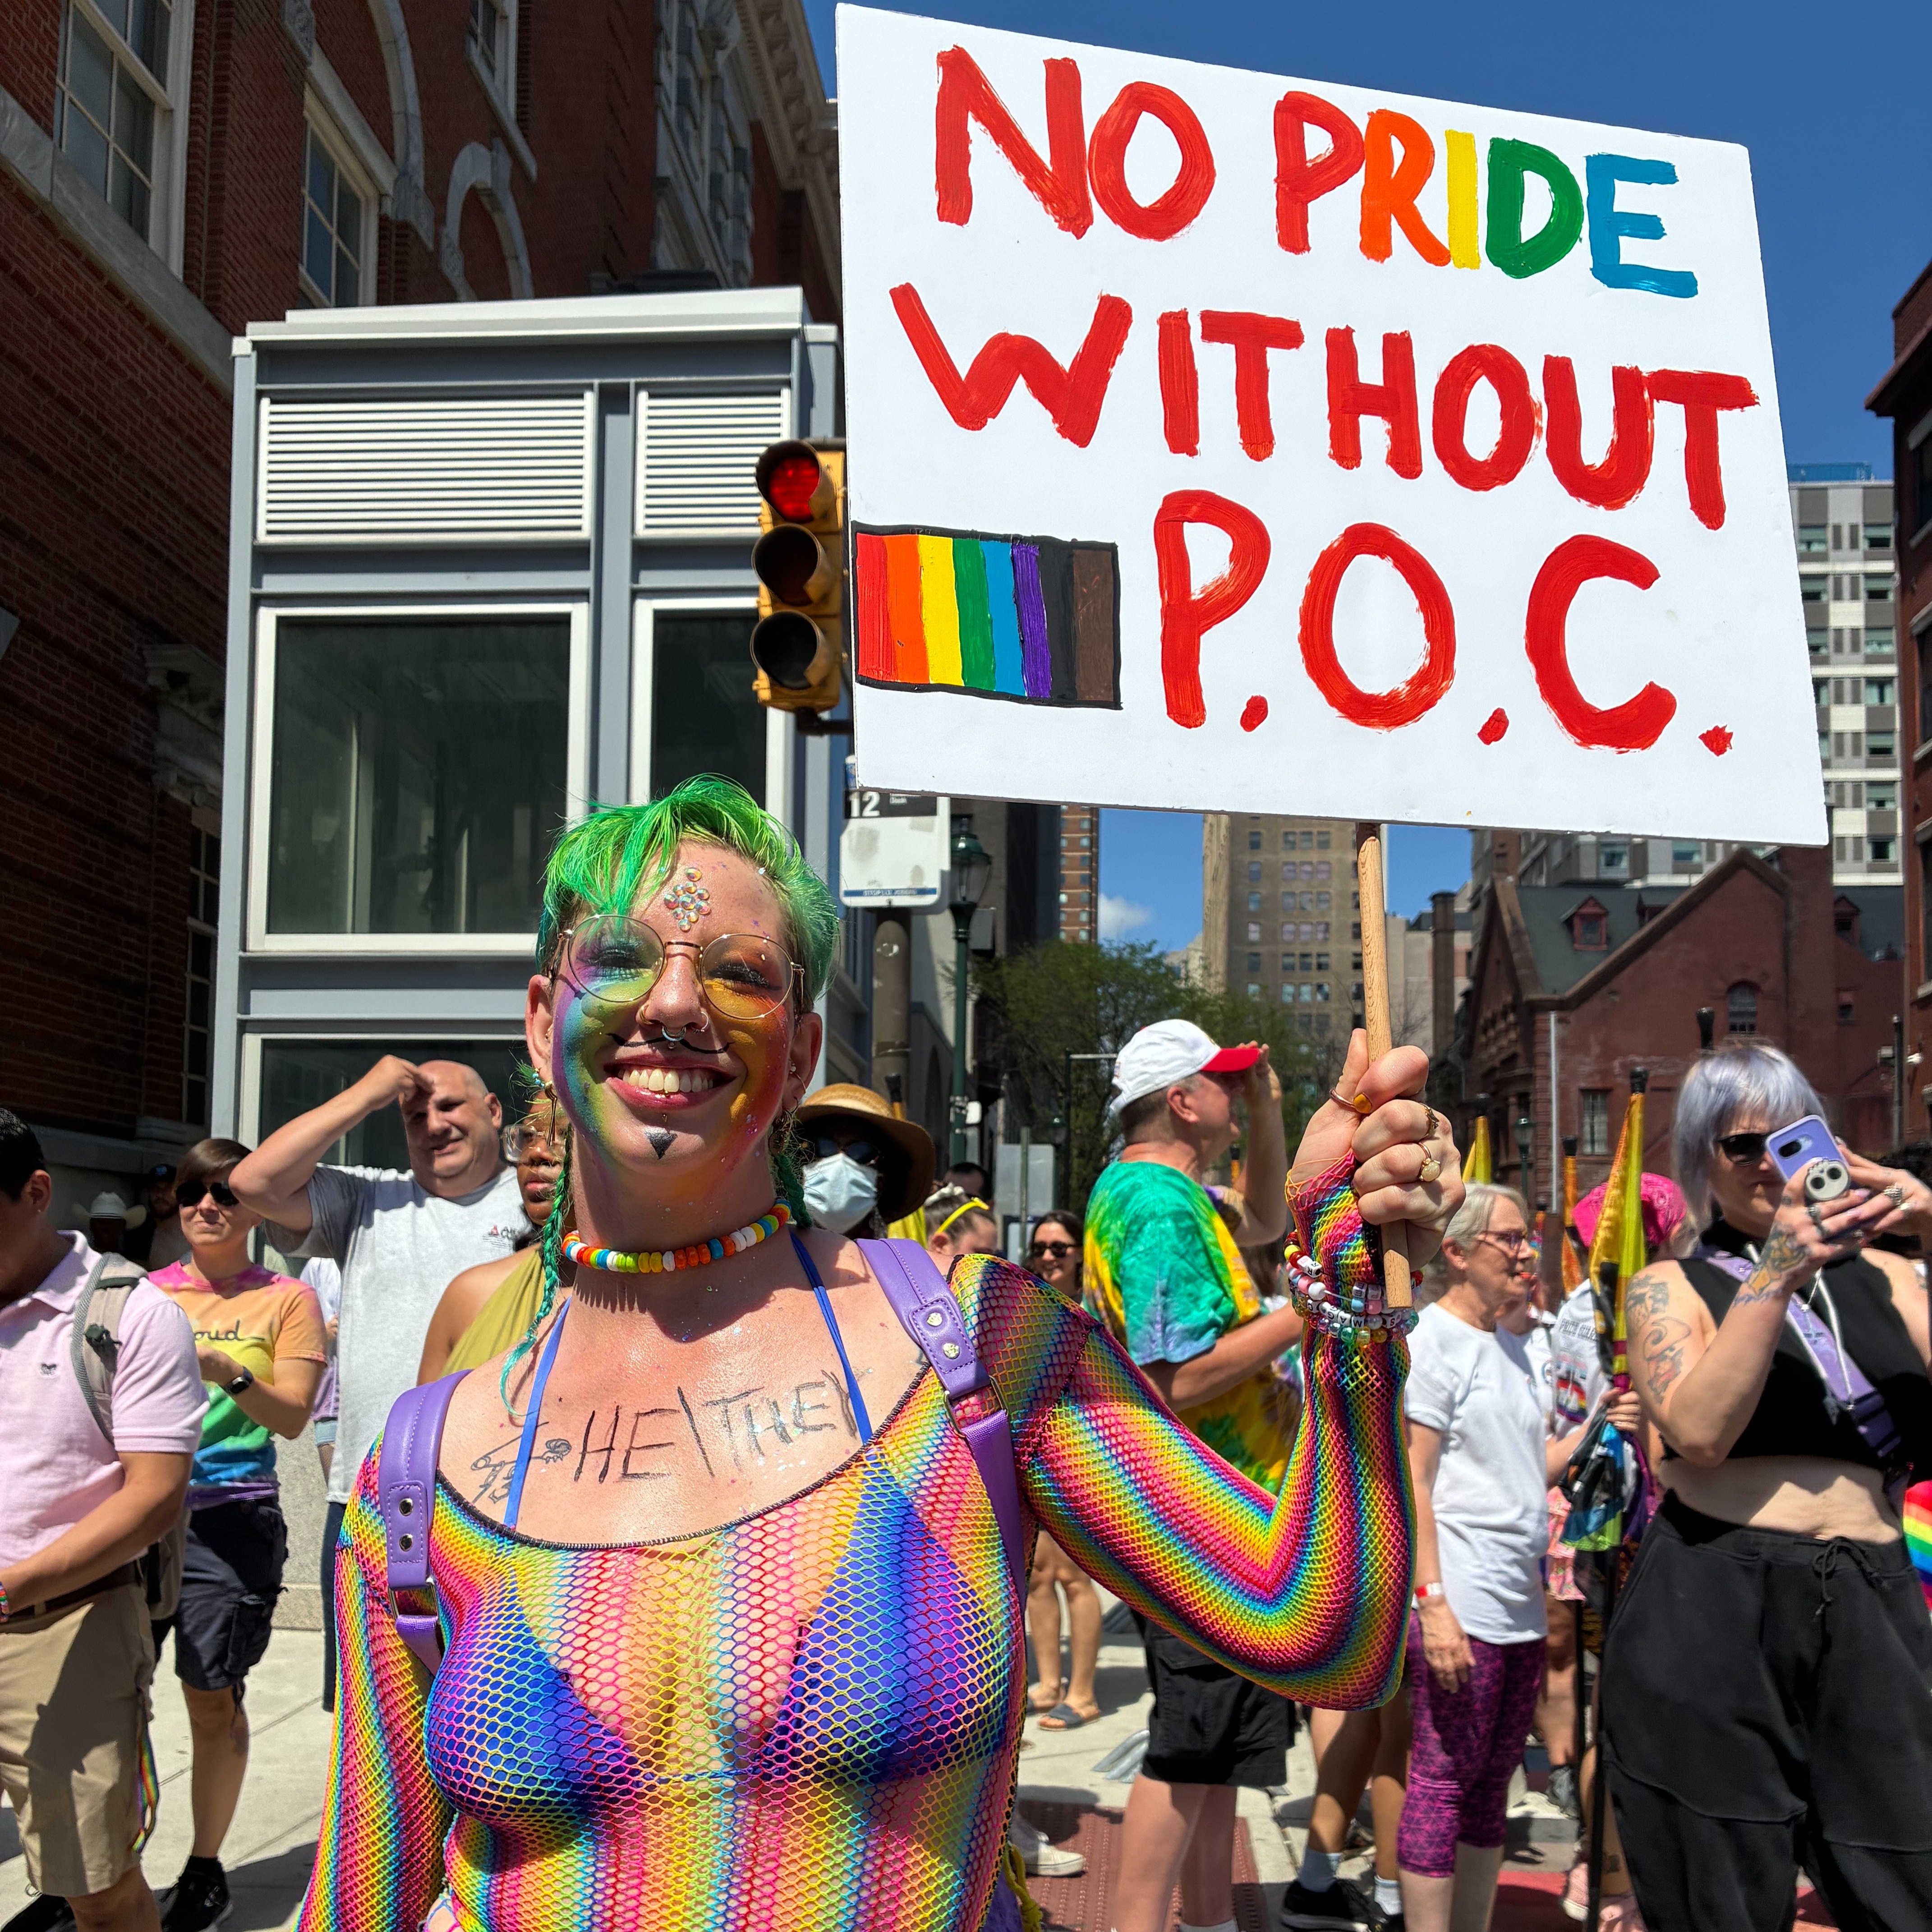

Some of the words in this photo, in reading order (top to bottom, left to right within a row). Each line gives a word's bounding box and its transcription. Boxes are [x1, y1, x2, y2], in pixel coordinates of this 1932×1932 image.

[934, 44, 1216, 242] NO
[1273, 91, 1699, 299] PRIDE
[889, 282, 1760, 531] WITHOUT
[1153, 490, 1733, 757] P.O.C.
[849, 791, 880, 817] 12
[194, 1318, 265, 1341] oud
